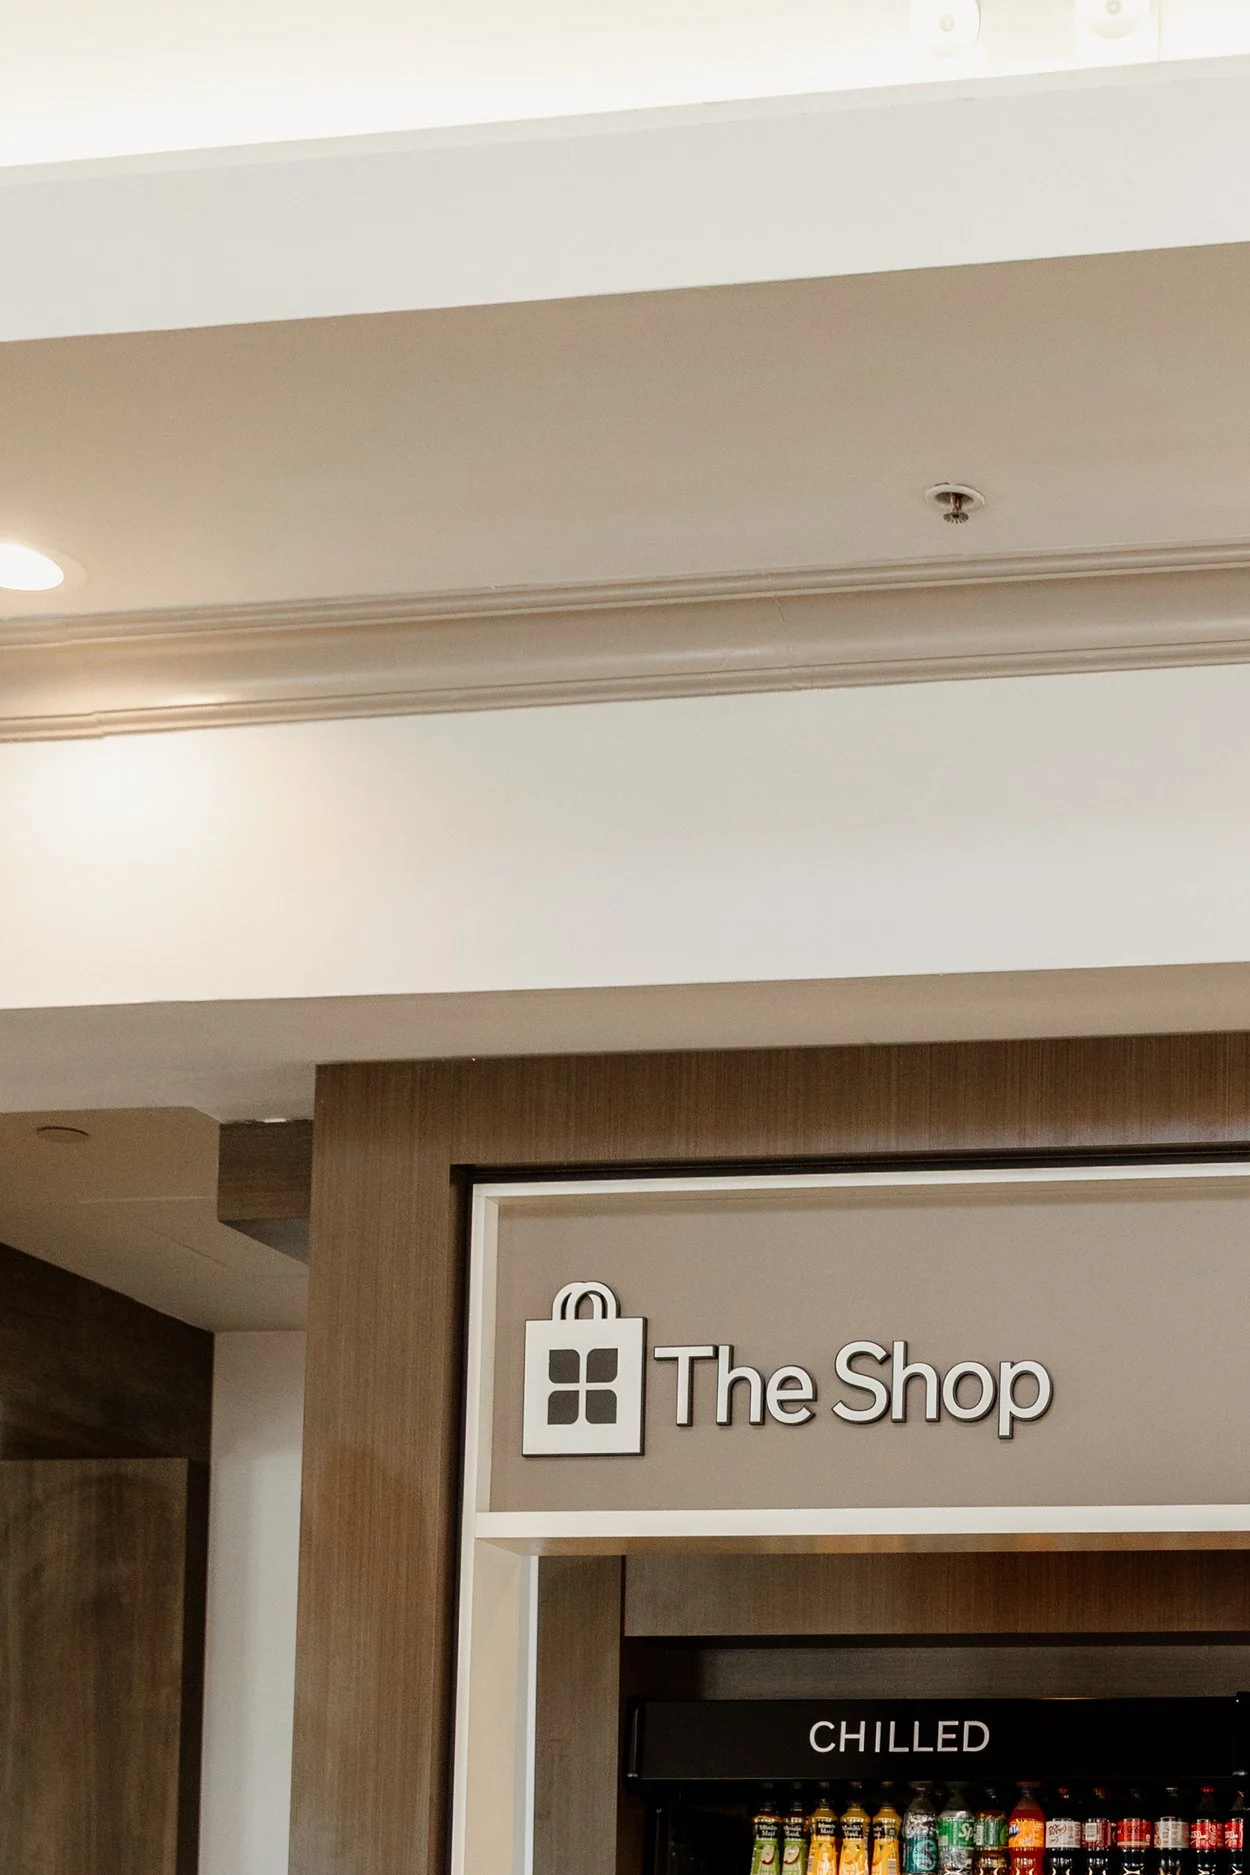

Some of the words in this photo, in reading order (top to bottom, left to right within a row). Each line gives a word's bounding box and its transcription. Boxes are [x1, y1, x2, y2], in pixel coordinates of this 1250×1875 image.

[654, 1344, 816, 1427] The
[832, 1340, 1053, 1439] Shop
[809, 1720, 991, 1754] CHILLED
